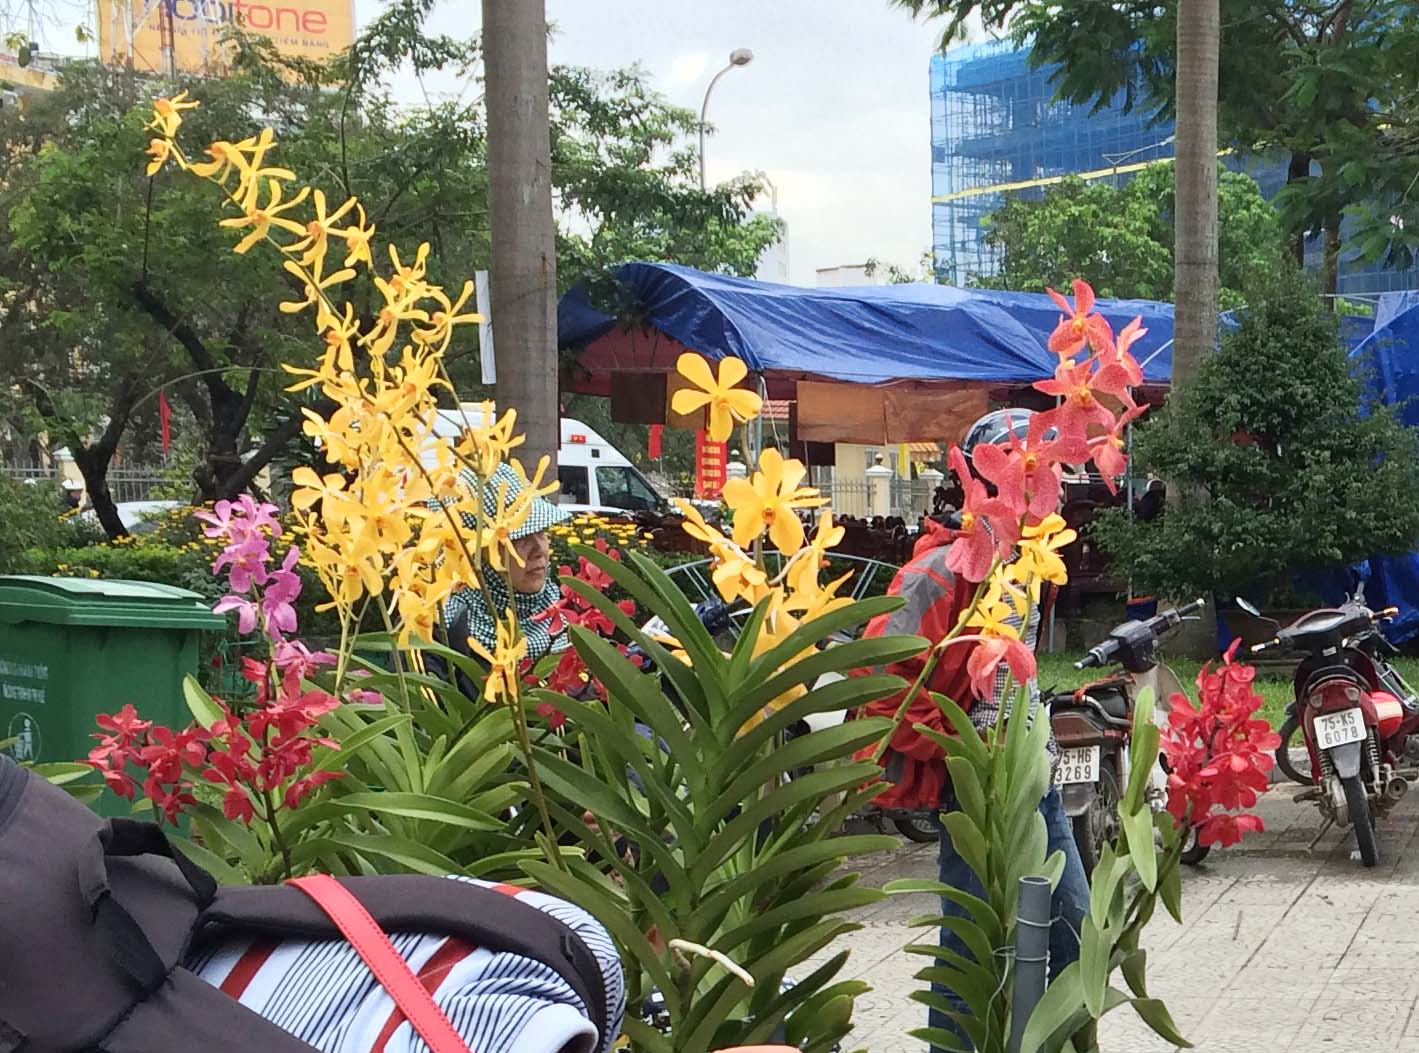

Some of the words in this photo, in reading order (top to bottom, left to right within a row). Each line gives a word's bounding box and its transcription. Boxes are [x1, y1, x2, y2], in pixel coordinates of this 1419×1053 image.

[1321, 712, 1356, 732] 75-K5
[1325, 726, 1358, 745] 6078
[1056, 765, 1092, 782] 3269
